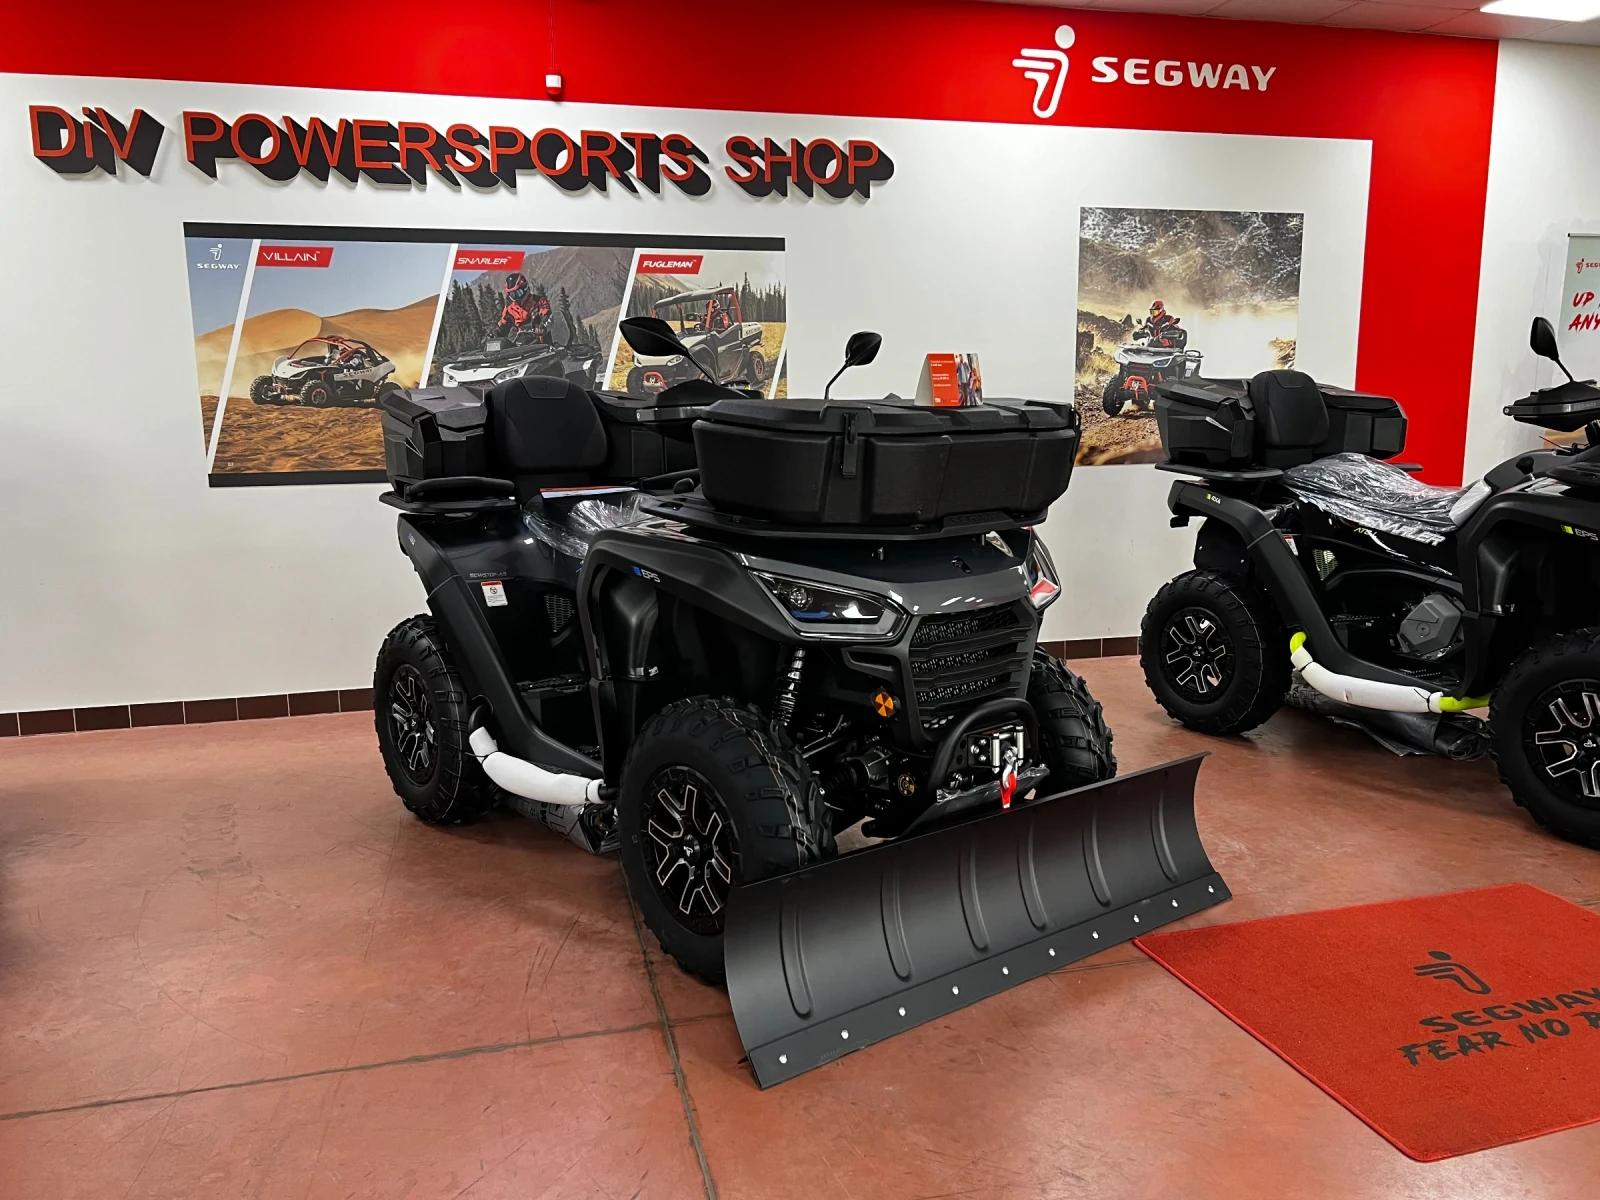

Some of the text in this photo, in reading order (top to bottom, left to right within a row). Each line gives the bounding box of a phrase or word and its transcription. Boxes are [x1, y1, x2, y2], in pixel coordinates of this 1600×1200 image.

[1091, 56, 1277, 92] SEGWAY
[29, 105, 879, 185] DiV POWERSPORTS SHOP
[1572, 291, 1595, 308] UP
[1574, 528, 1599, 541] EPS
[641, 568, 661, 583] EPS
[1419, 987, 1600, 1033] SEGWAY
[1397, 1030, 1522, 1067] FEAR
[1517, 1018, 1571, 1044] NO
